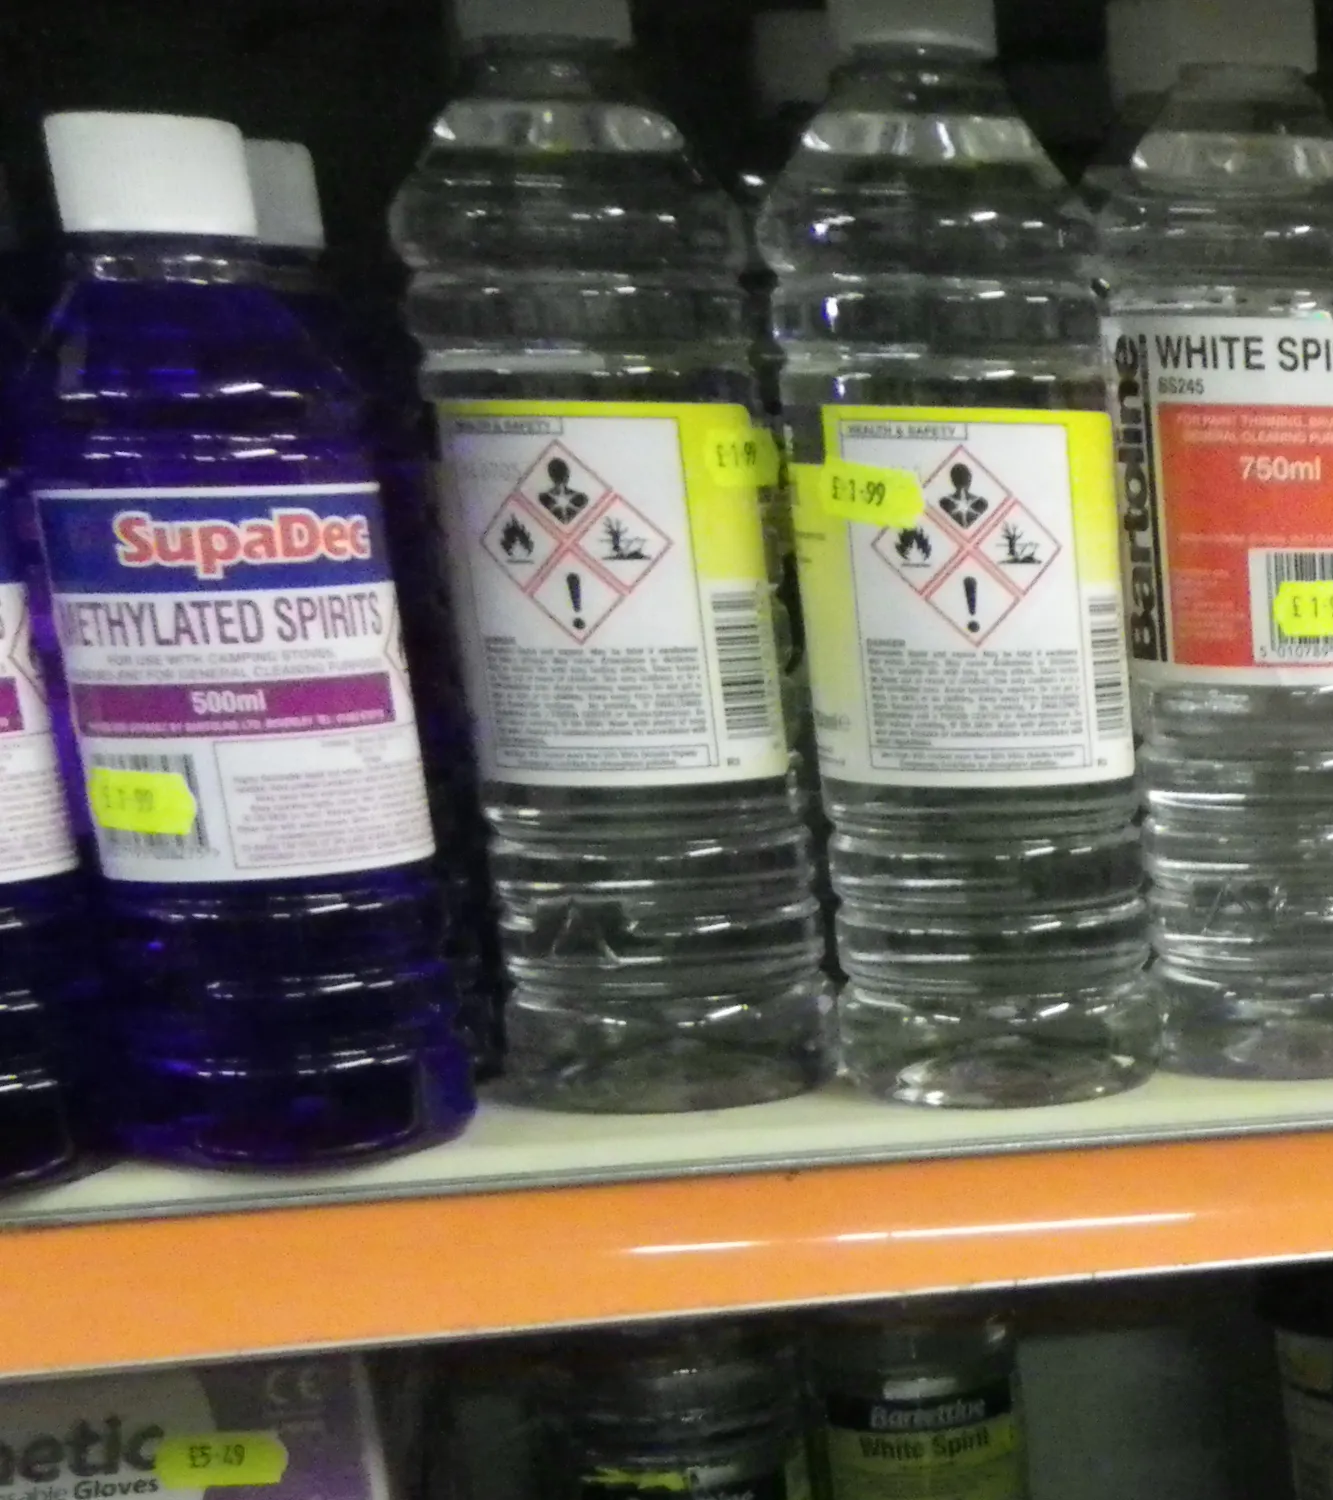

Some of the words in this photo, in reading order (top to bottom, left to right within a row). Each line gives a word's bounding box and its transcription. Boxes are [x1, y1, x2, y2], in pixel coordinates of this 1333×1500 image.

[1155, 336, 1266, 371] WHITE
[1239, 455, 1322, 482] 750ml
[1115, 334, 1158, 662] Bartoline
[113, 507, 372, 580] SupaDec
[276, 591, 384, 642] SPIRITS
[191, 689, 267, 715] 500ml
[858, 1433, 925, 1460] White
[931, 1427, 991, 1458] Spirit
[73, 1476, 159, 1500] Gloves
